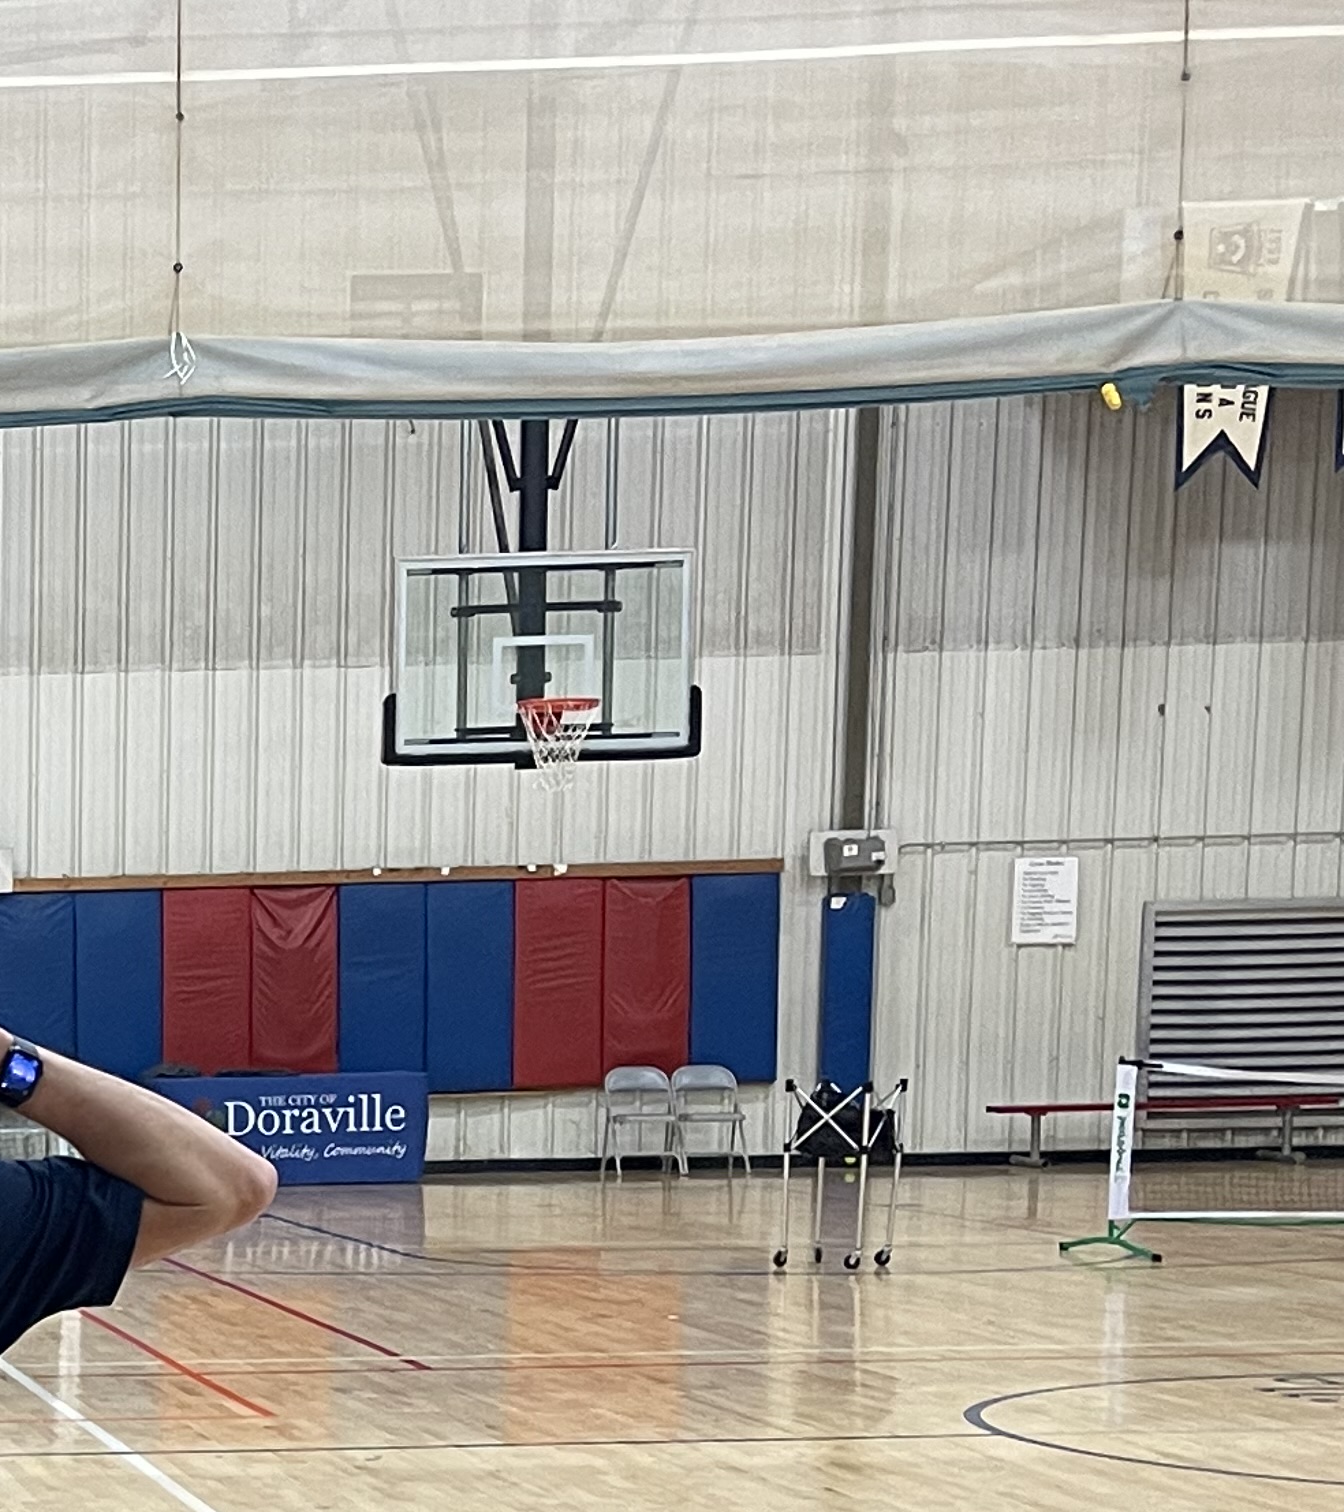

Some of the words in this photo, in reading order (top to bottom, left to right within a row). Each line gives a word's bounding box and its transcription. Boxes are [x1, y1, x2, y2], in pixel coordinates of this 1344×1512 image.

[1195, 385, 1213, 420] NS
[1239, 385, 1259, 423] GUE
[224, 1093, 406, 1137] Doraville
[258, 1095, 286, 1107] THE
[288, 1094, 317, 1107] CITY
[319, 1093, 337, 1104] OF
[323, 1139, 407, 1159] Community
